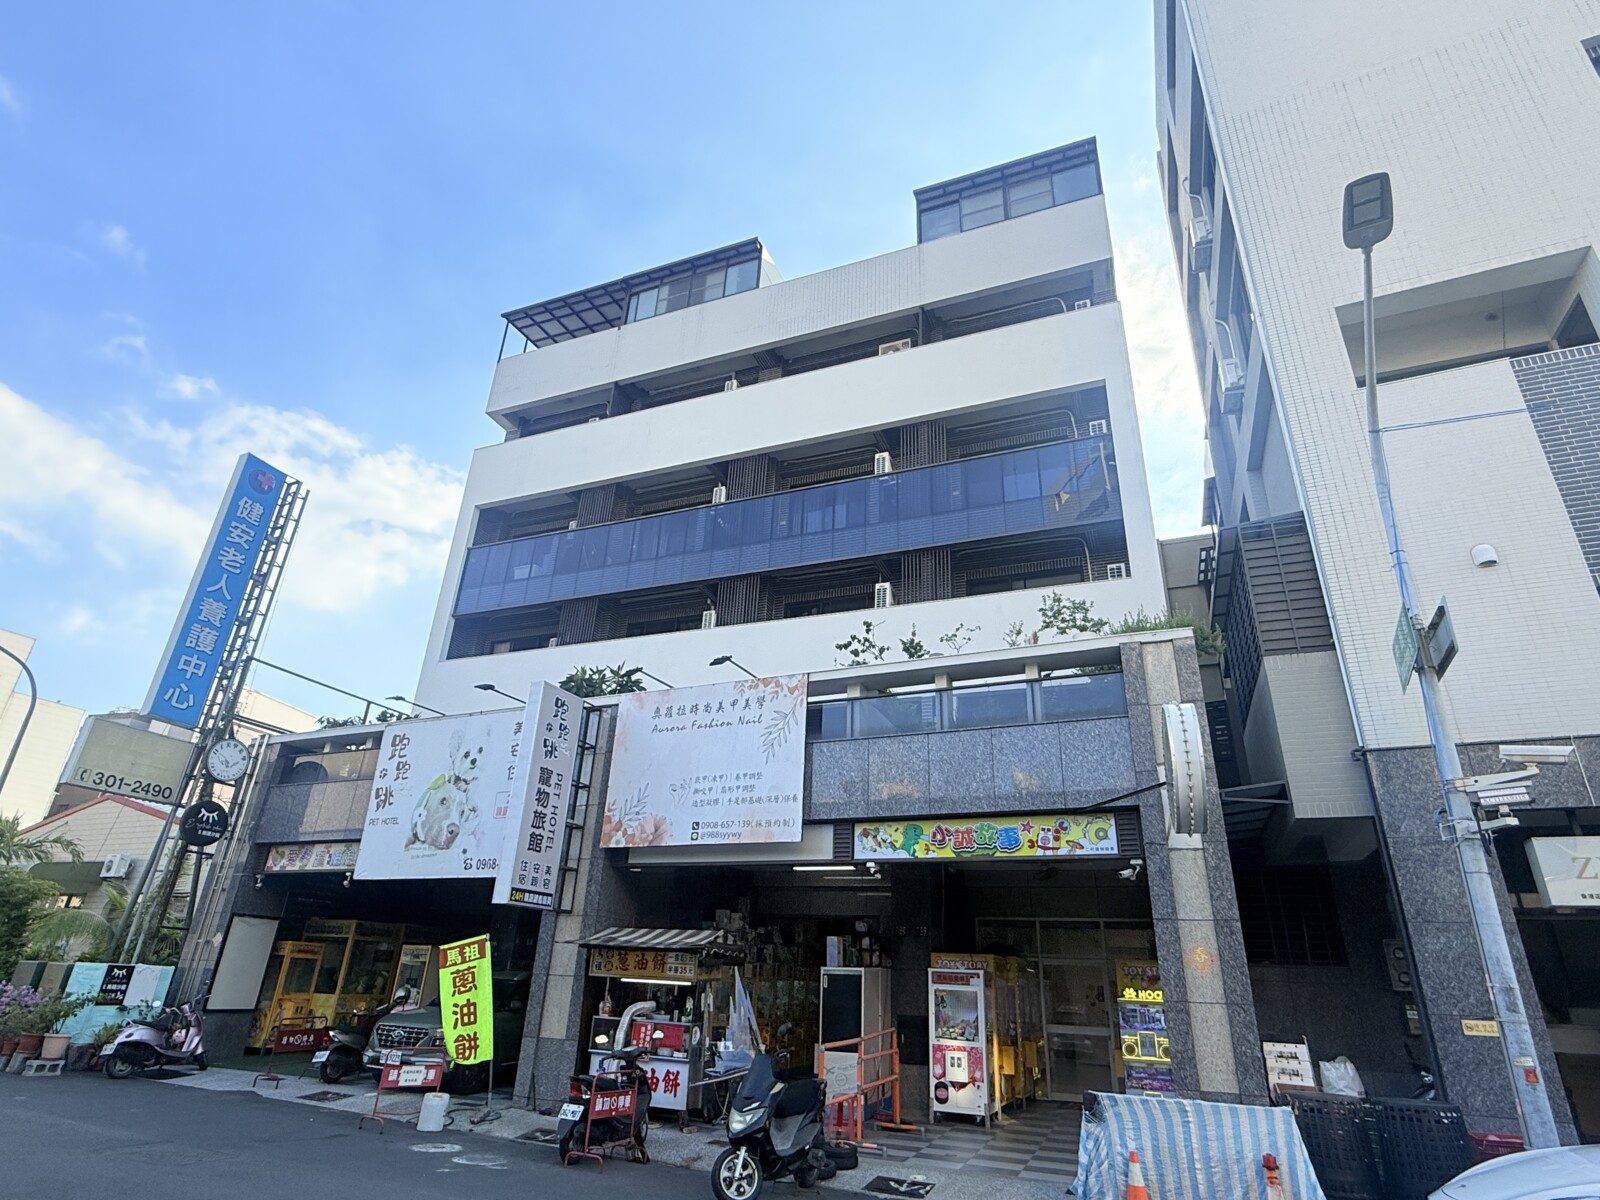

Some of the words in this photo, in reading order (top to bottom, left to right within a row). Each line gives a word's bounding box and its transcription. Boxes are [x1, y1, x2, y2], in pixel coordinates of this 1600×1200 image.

[163, 496, 264, 710] 健安老人養護中心
[651, 724, 687, 734] Aurora
[691, 718, 733, 731] Fashion
[738, 713, 763, 726] Nail
[93, 772, 173, 799] 301-2490
[552, 772, 564, 800] PET
[368, 818, 379, 826] PET
[381, 817, 399, 826] HOTEL
[526, 766, 554, 854] 寵物旅館
[544, 805, 559, 853] HOTEL
[446, 943, 480, 967] 馬祖
[450, 965, 479, 1061] 蔥油餅
